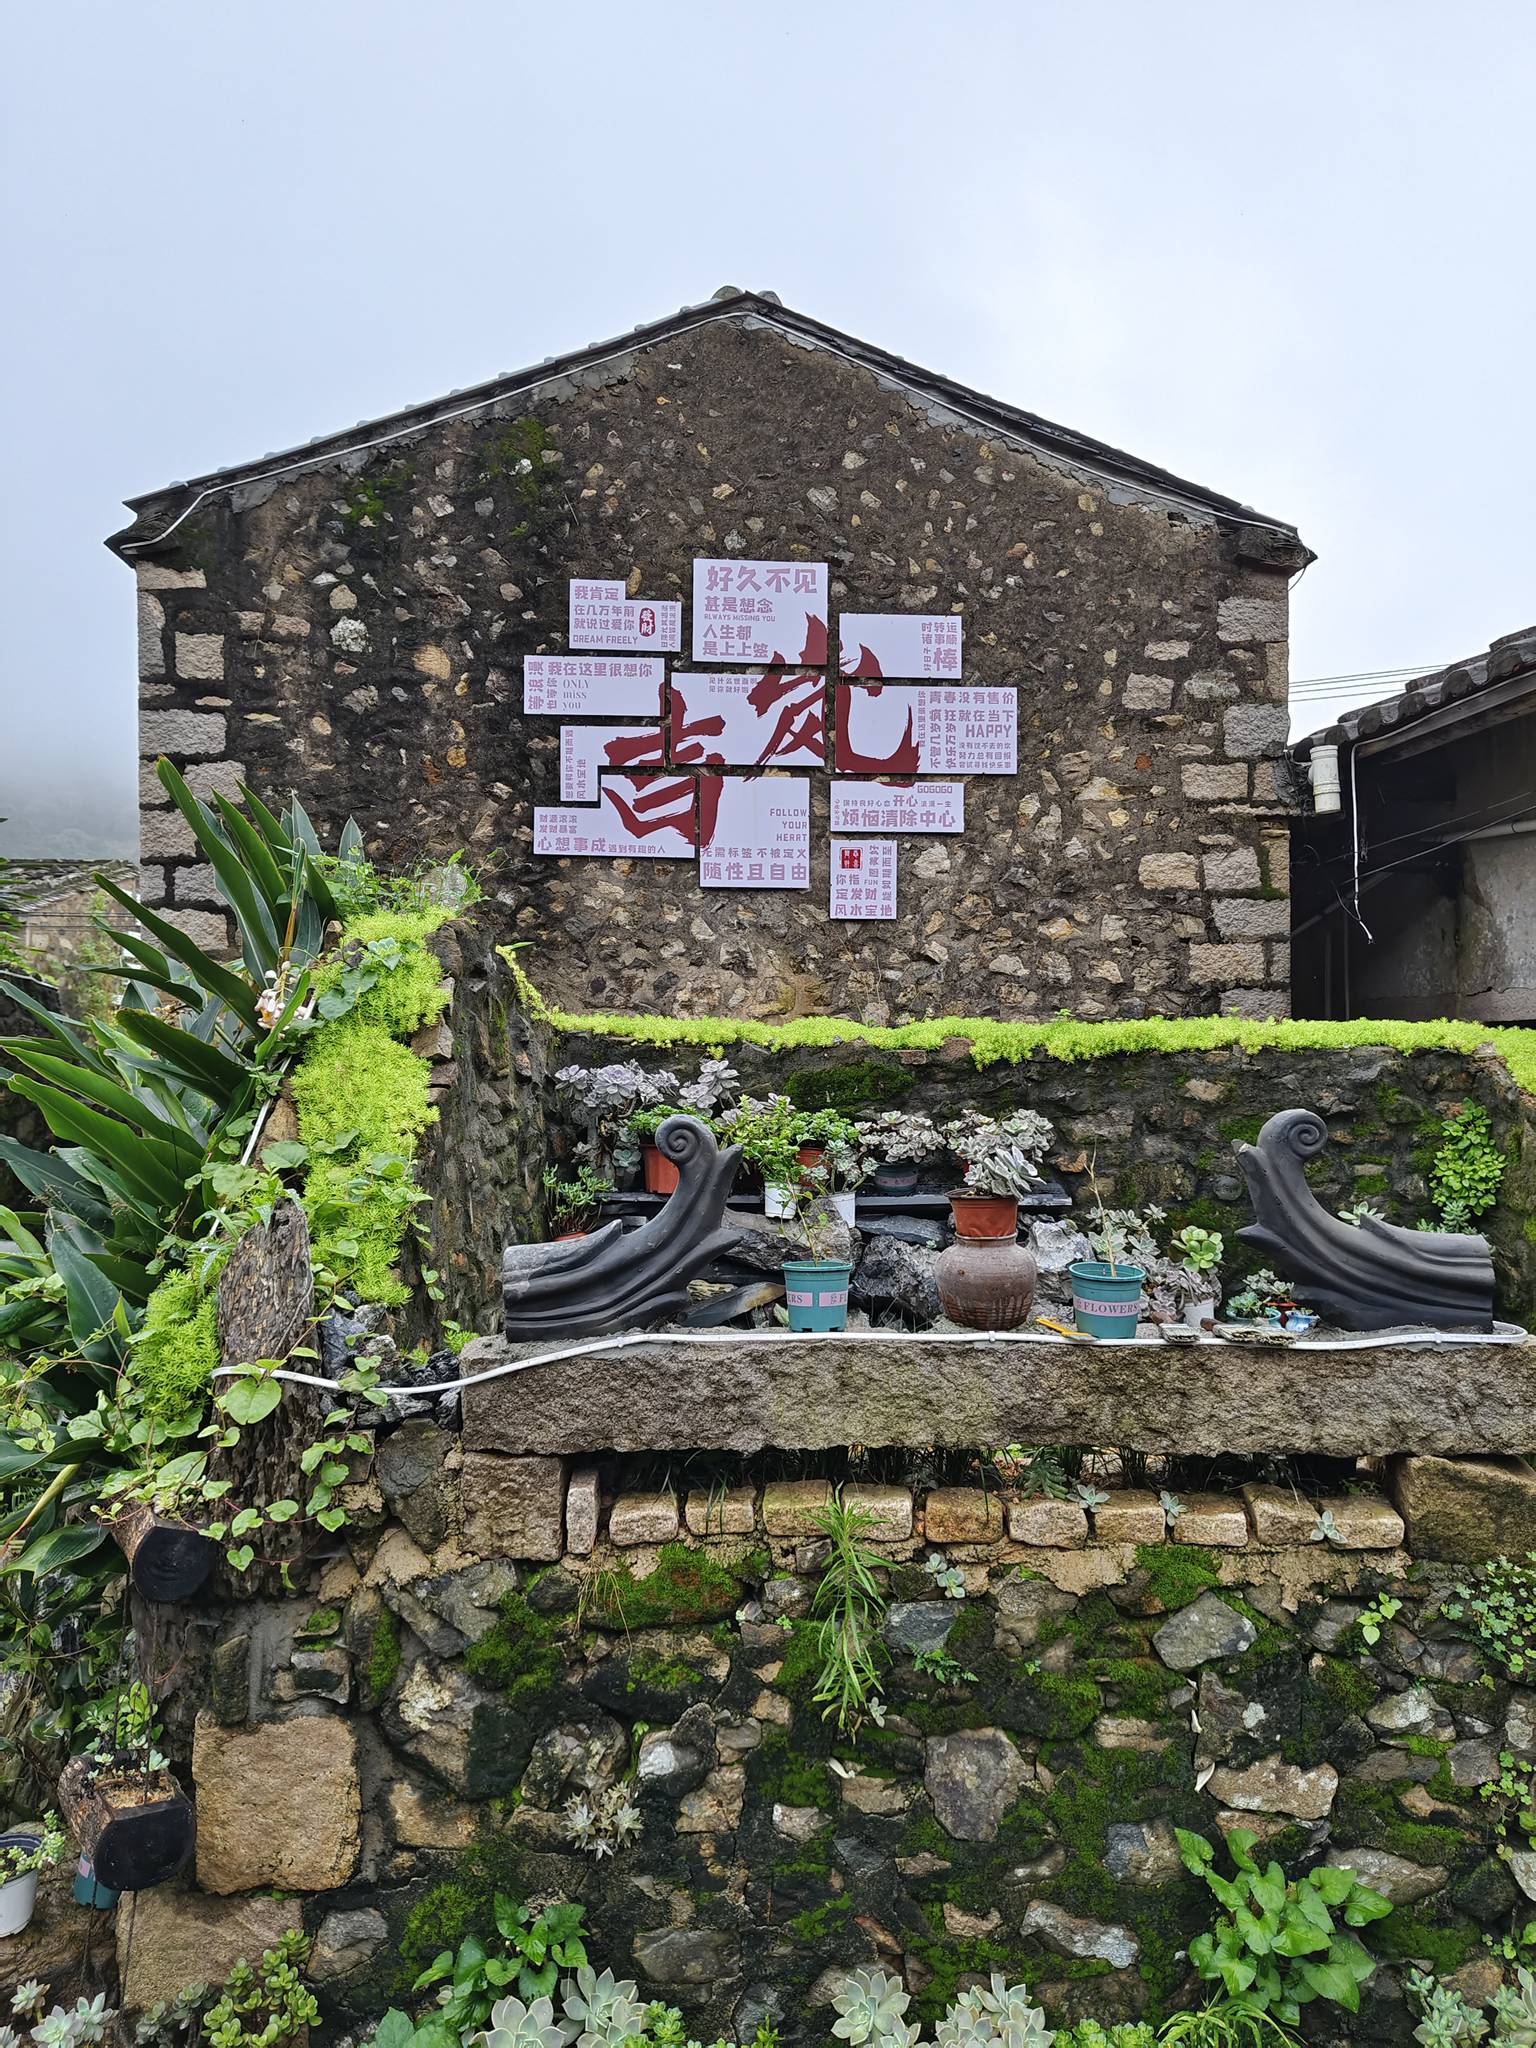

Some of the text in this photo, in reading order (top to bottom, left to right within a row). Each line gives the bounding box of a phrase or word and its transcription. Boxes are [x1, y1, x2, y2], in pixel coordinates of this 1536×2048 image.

[705, 565, 818, 594] 好久不见
[574, 585, 619, 600] 我肯定
[574, 604, 635, 617] 在几万年前
[704, 596, 773, 613] 甚是想念
[574, 618, 635, 630] 就说过爱你
[703, 624, 752, 640] 人生都
[573, 634, 638, 644] DREAM FREELY
[703, 641, 769, 658] 是上上签
[923, 647, 932, 671] 好日子
[933, 647, 958, 671] 棒
[548, 662, 653, 676] 我在这里很想你
[528, 661, 544, 709] 等浪漫
[563, 679, 590, 688] ONLY
[563, 690, 587, 699] miss
[929, 691, 1015, 704] 青春没有售价
[562, 702, 581, 711] you
[929, 709, 1015, 722] 疯狂就在当下
[965, 724, 1012, 738] HAPPY
[929, 723, 942, 769] 不管几岁
[944, 723, 957, 769] 快乐万岁
[959, 752, 1011, 760] 努力总有回报
[576, 758, 586, 800] 风水宝地
[917, 785, 953, 793] GOGOGO
[893, 794, 918, 808] 开心
[769, 808, 807, 817] FOLLOW
[842, 808, 956, 828] 烦恼清除中心
[782, 821, 807, 829] YOUR
[537, 836, 666, 854] 心想事成 遇到有趣的人
[701, 847, 807, 859] 无需标签 不被定义
[703, 862, 807, 881] 随性且自由
[836, 874, 859, 885] 你指
[835, 888, 877, 900] 定发财
[835, 904, 893, 916] 风水宝地
[1084, 1302, 1139, 1314] FLOWERS
